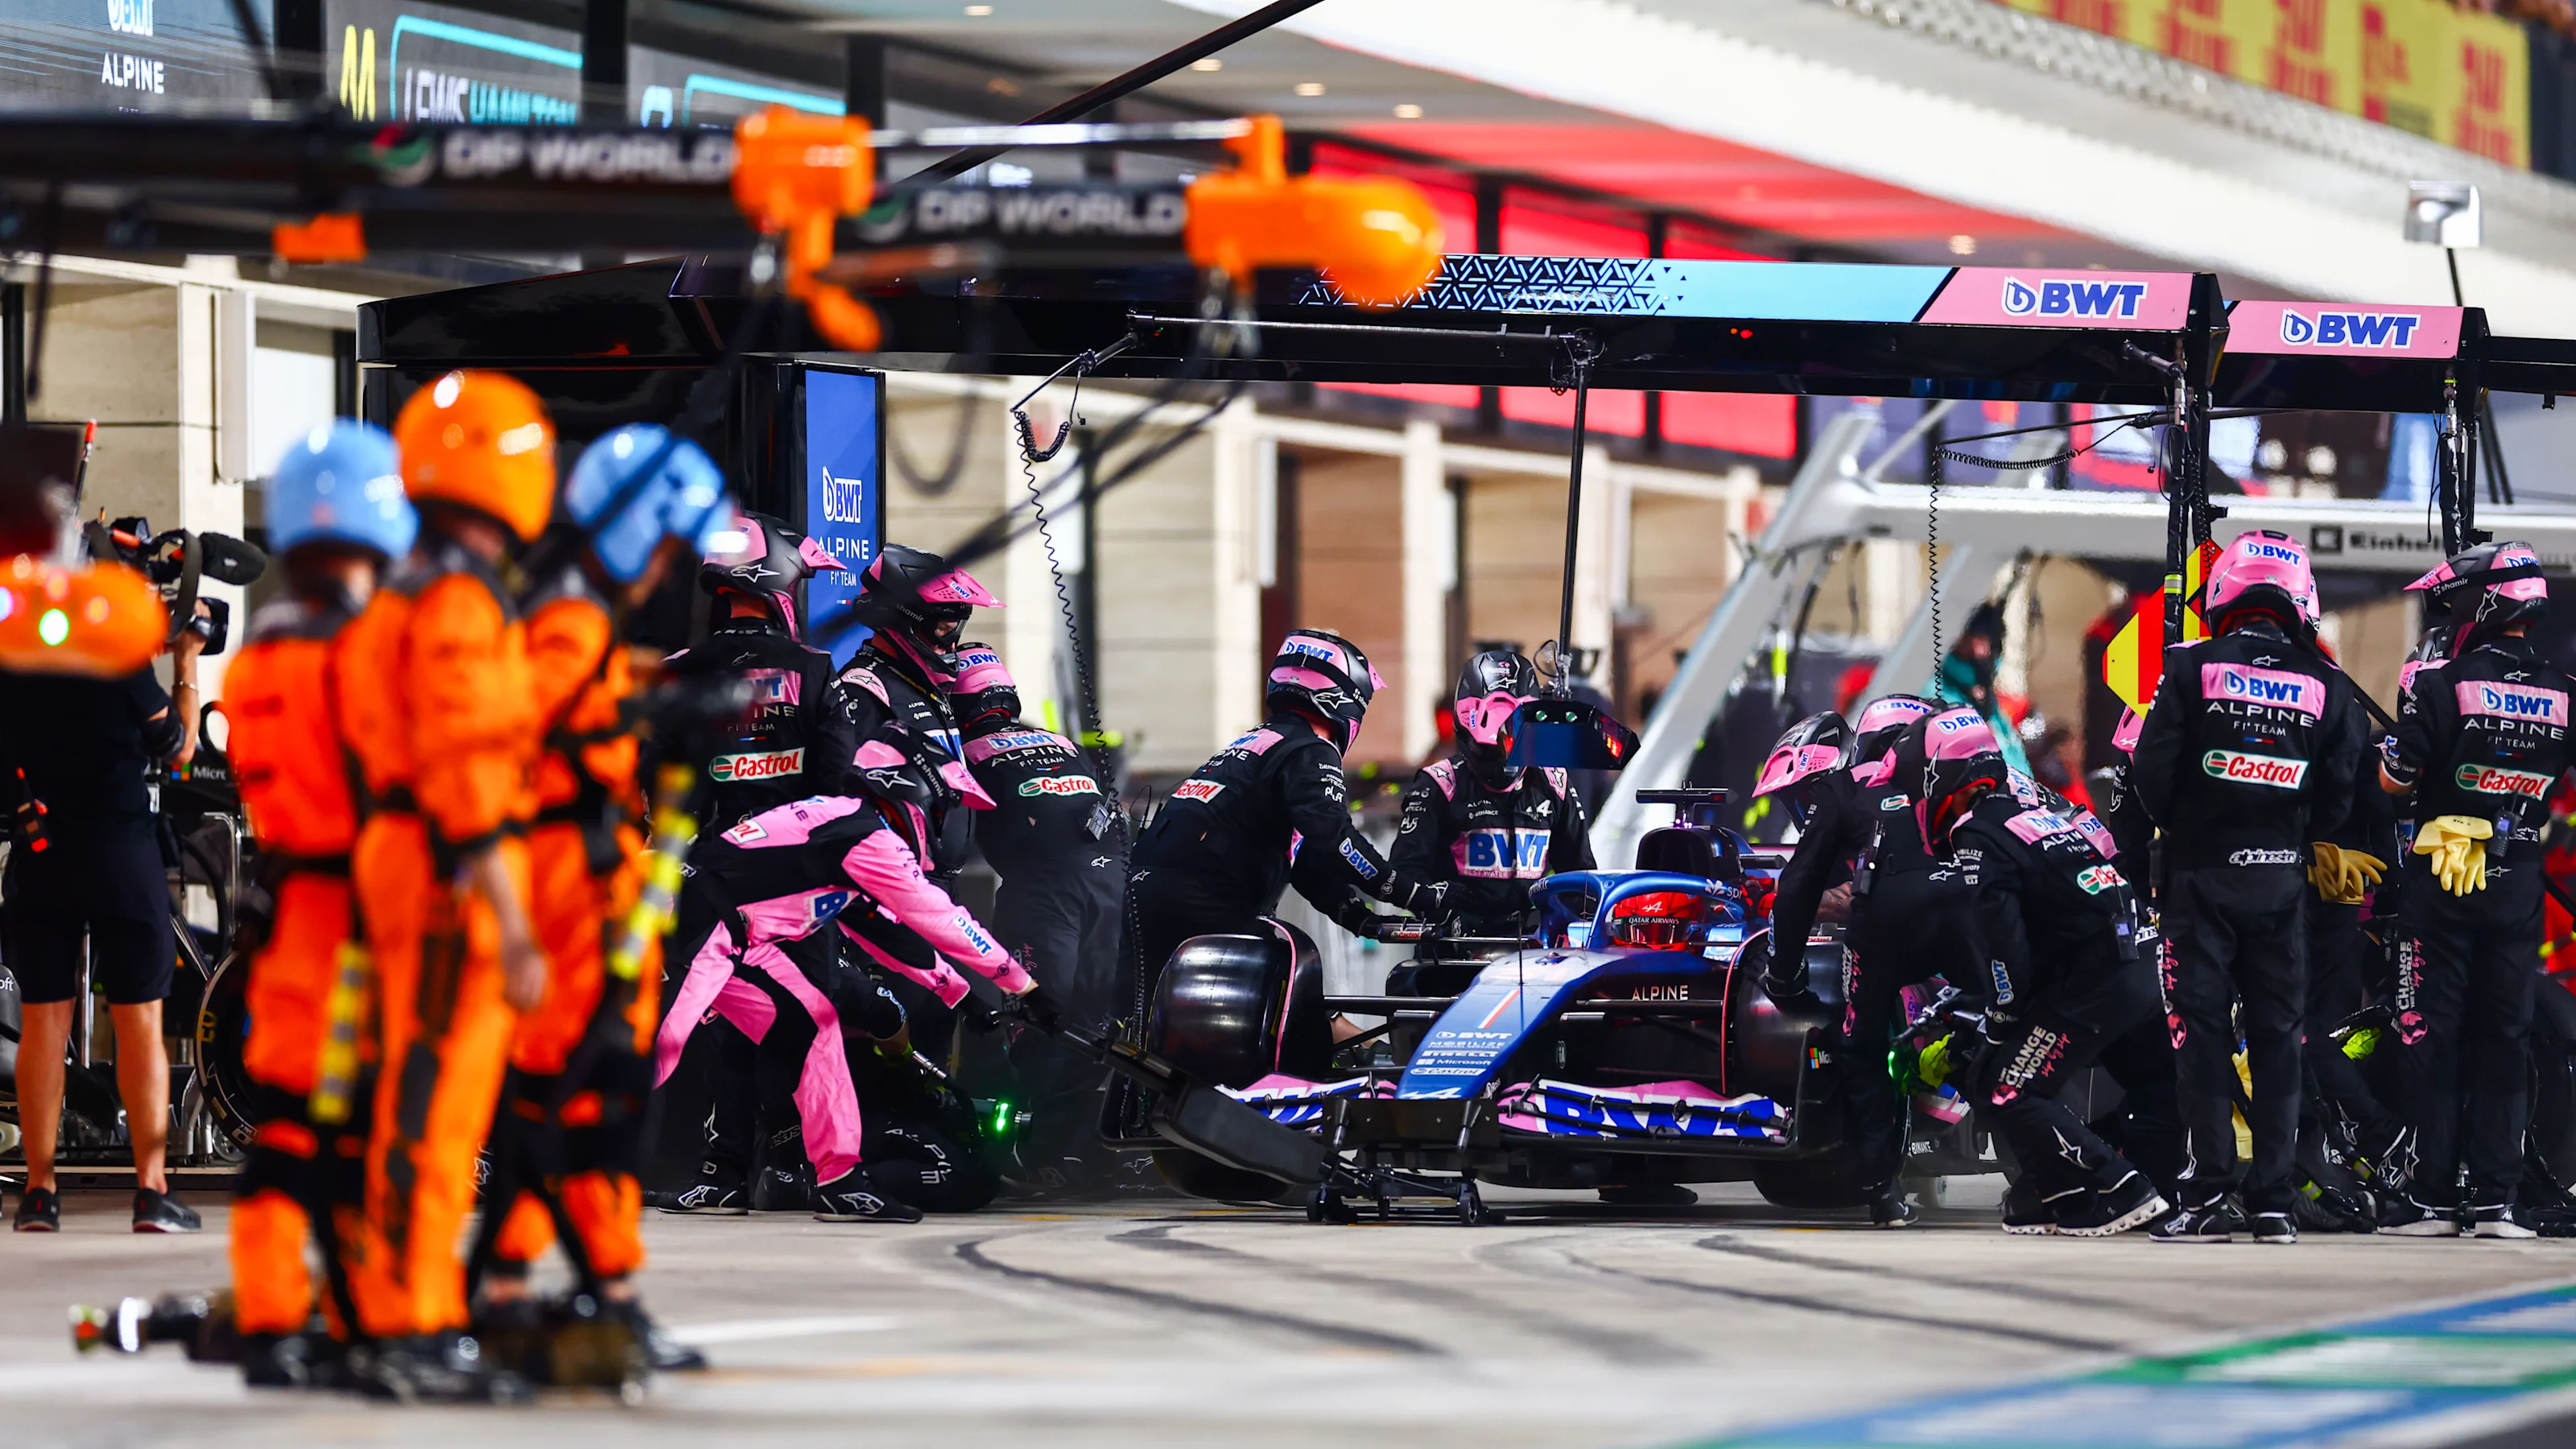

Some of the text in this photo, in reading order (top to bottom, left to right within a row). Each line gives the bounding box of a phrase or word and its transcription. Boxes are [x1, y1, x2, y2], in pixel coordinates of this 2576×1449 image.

[101, 52, 164, 94] ALPINE
[443, 129, 739, 187] DP WORLD
[916, 187, 1187, 237] DP WORLD
[2039, 279, 2147, 320] BWT
[2315, 312, 2420, 350] BWT
[833, 477, 862, 523] BWT
[817, 535, 870, 561] ALPINE
[2349, 530, 2445, 555] Einhel
[2263, 544, 2301, 567] BWT
[840, 572, 857, 587] TEAM
[2441, 577, 2469, 592] shamir
[954, 584, 971, 600] BWT
[968, 653, 1001, 666] BWT
[1297, 643, 1334, 662] BWT
[2249, 678, 2302, 704] BWT
[752, 705, 795, 718] INE
[1890, 701, 1932, 715] BWT
[2206, 700, 2315, 729] ALPINE
[2504, 693, 2553, 717] BWT
[1955, 715, 1985, 728] BWT
[2253, 724, 2286, 737] TEAM
[2464, 717, 2566, 741] ALPINE
[1011, 733, 1056, 748] BWT
[2505, 738, 2536, 749] TEAM
[734, 750, 799, 778] Castrol
[991, 745, 1077, 768] ALPINE
[1037, 757, 1064, 766] TEAM
[1214, 748, 1249, 762] PINE
[1800, 753, 1810, 767] BWT
[921, 764, 944, 798] shamir
[2227, 756, 2300, 784] Castrol
[1042, 779, 1094, 793] Castrol
[2479, 770, 2547, 796] Castrol
[1468, 832, 1549, 869] BWT
[2041, 830, 2083, 852] ALPIN
[1348, 848, 1378, 880] BWT
[1484, 870, 1509, 878] WATER
[1387, 869, 1397, 885] Ross
[1628, 917, 1680, 925] QATAR AIRWAYS
[964, 924, 993, 956] BWT
[1398, 931, 1420, 939] Castrol
[1992, 960, 2013, 993] BWT
[2398, 941, 2410, 1011] CHANGE
[1632, 985, 1689, 1001] ALPINE
[1422, 1050, 1499, 1058] PIRELLI
[2005, 1026, 2047, 1086] CHANGE
[2021, 1032, 2058, 1080] WORLD
[2041, 1061, 2055, 1077] sip
[2048, 1048, 2064, 1060] by
[1912, 1141, 1934, 1154] BINANCE
